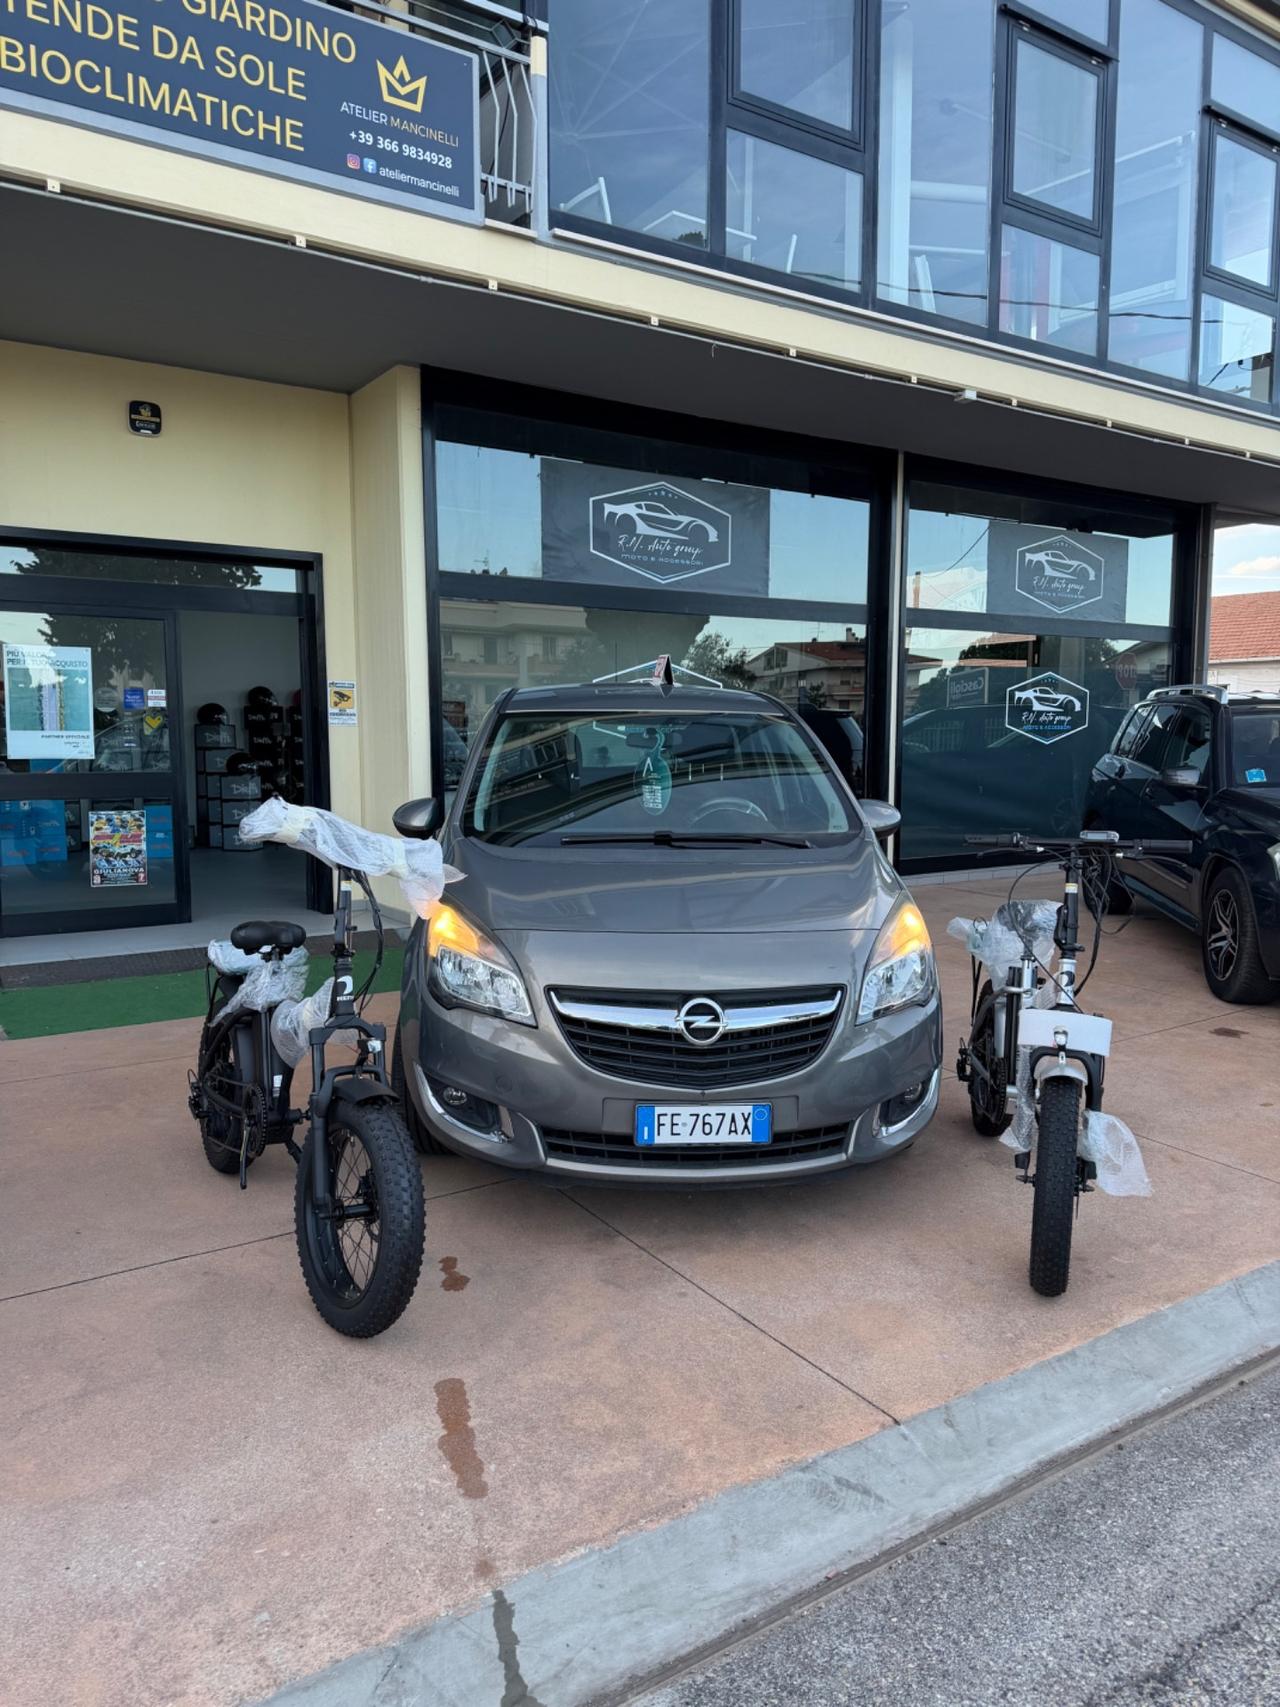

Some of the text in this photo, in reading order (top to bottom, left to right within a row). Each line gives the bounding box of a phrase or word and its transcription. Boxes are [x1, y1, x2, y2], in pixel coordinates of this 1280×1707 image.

[153, 24, 205, 70] DA
[215, 46, 307, 101] SOLE
[0, 35, 304, 151] BIOCLIMATICHE
[340, 101, 459, 148] ATELIER MANCINELLI
[349, 130, 453, 169] +39 366 9834928
[379, 166, 459, 197] ateliermancinelli
